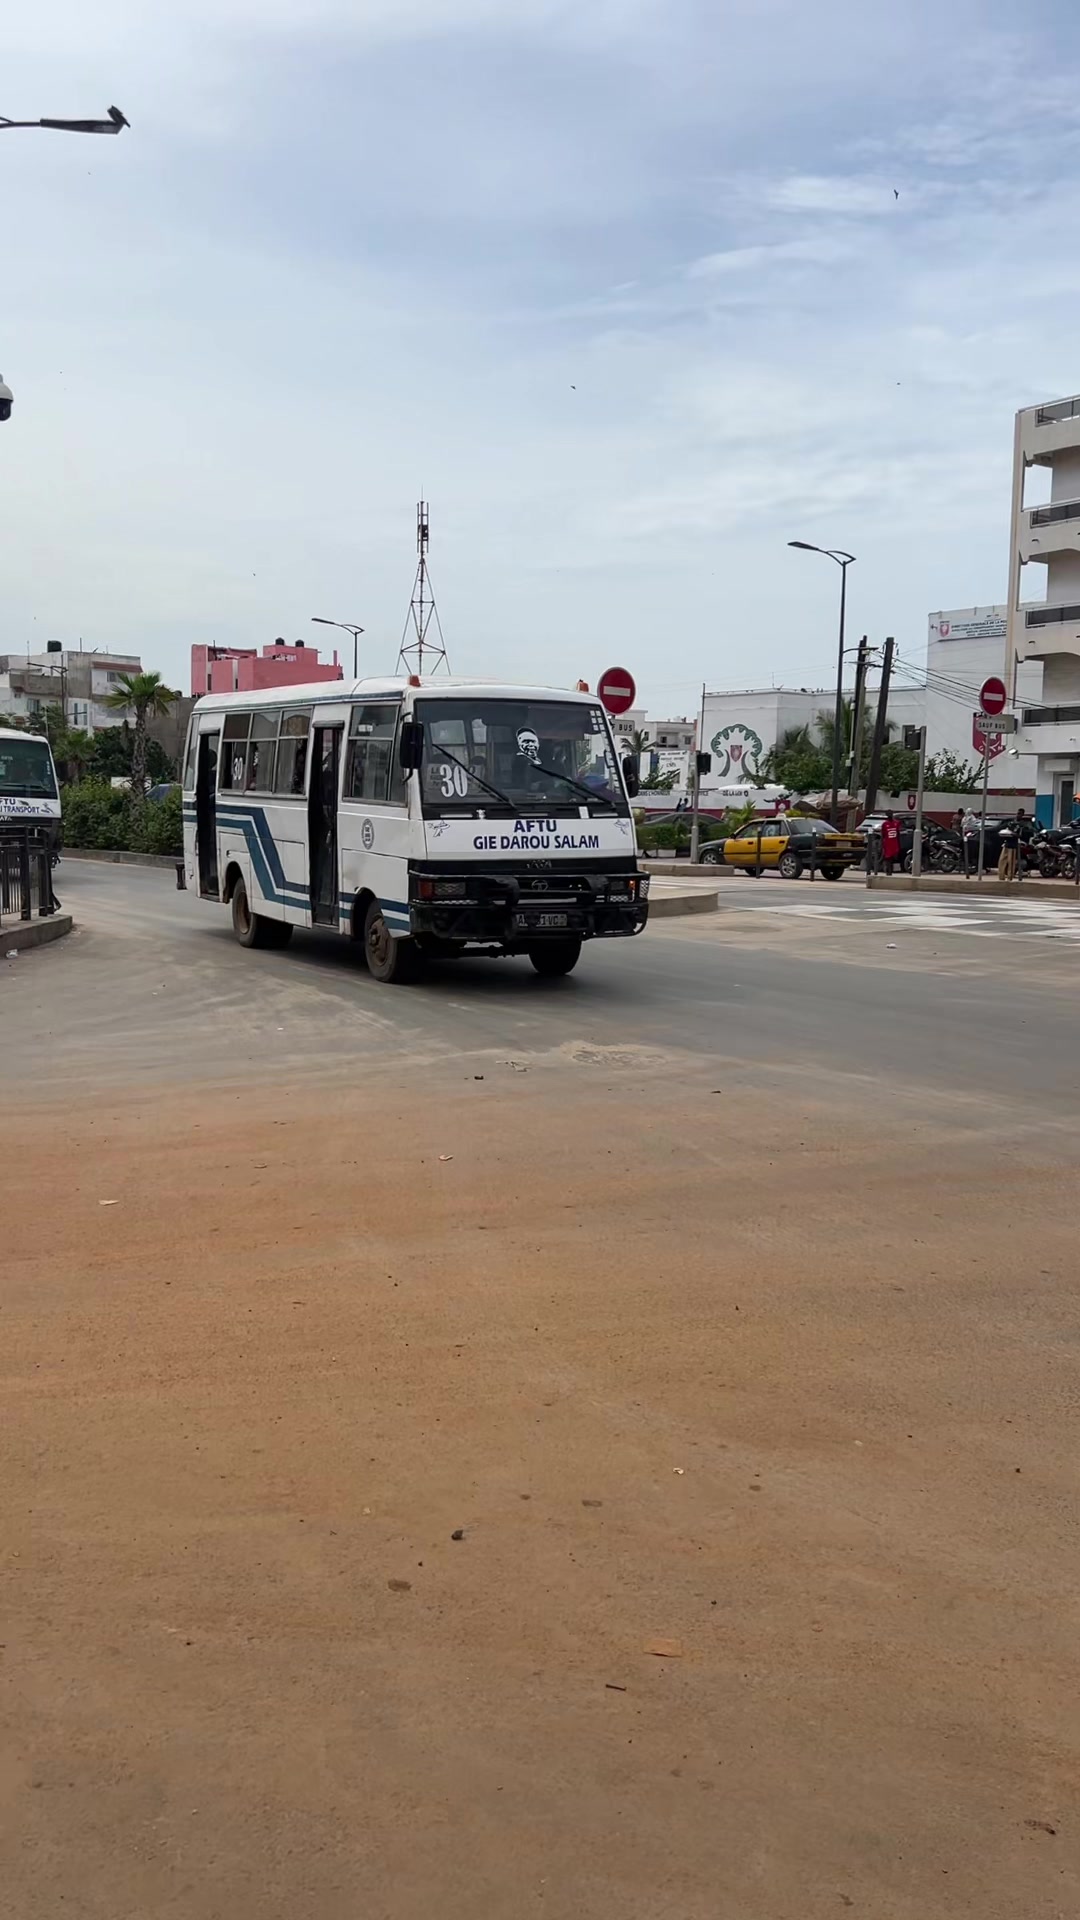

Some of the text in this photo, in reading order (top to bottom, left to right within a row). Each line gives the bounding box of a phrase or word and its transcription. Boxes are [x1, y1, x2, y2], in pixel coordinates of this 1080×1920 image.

[618, 723, 633, 731] BUS
[978, 721, 1006, 730] SAUF BUS
[440, 763, 468, 798] 30
[4, 806, 40, 814] TRANSPORT
[513, 819, 557, 833] AFTU
[473, 834, 600, 850] GIE DAROU SALAM
